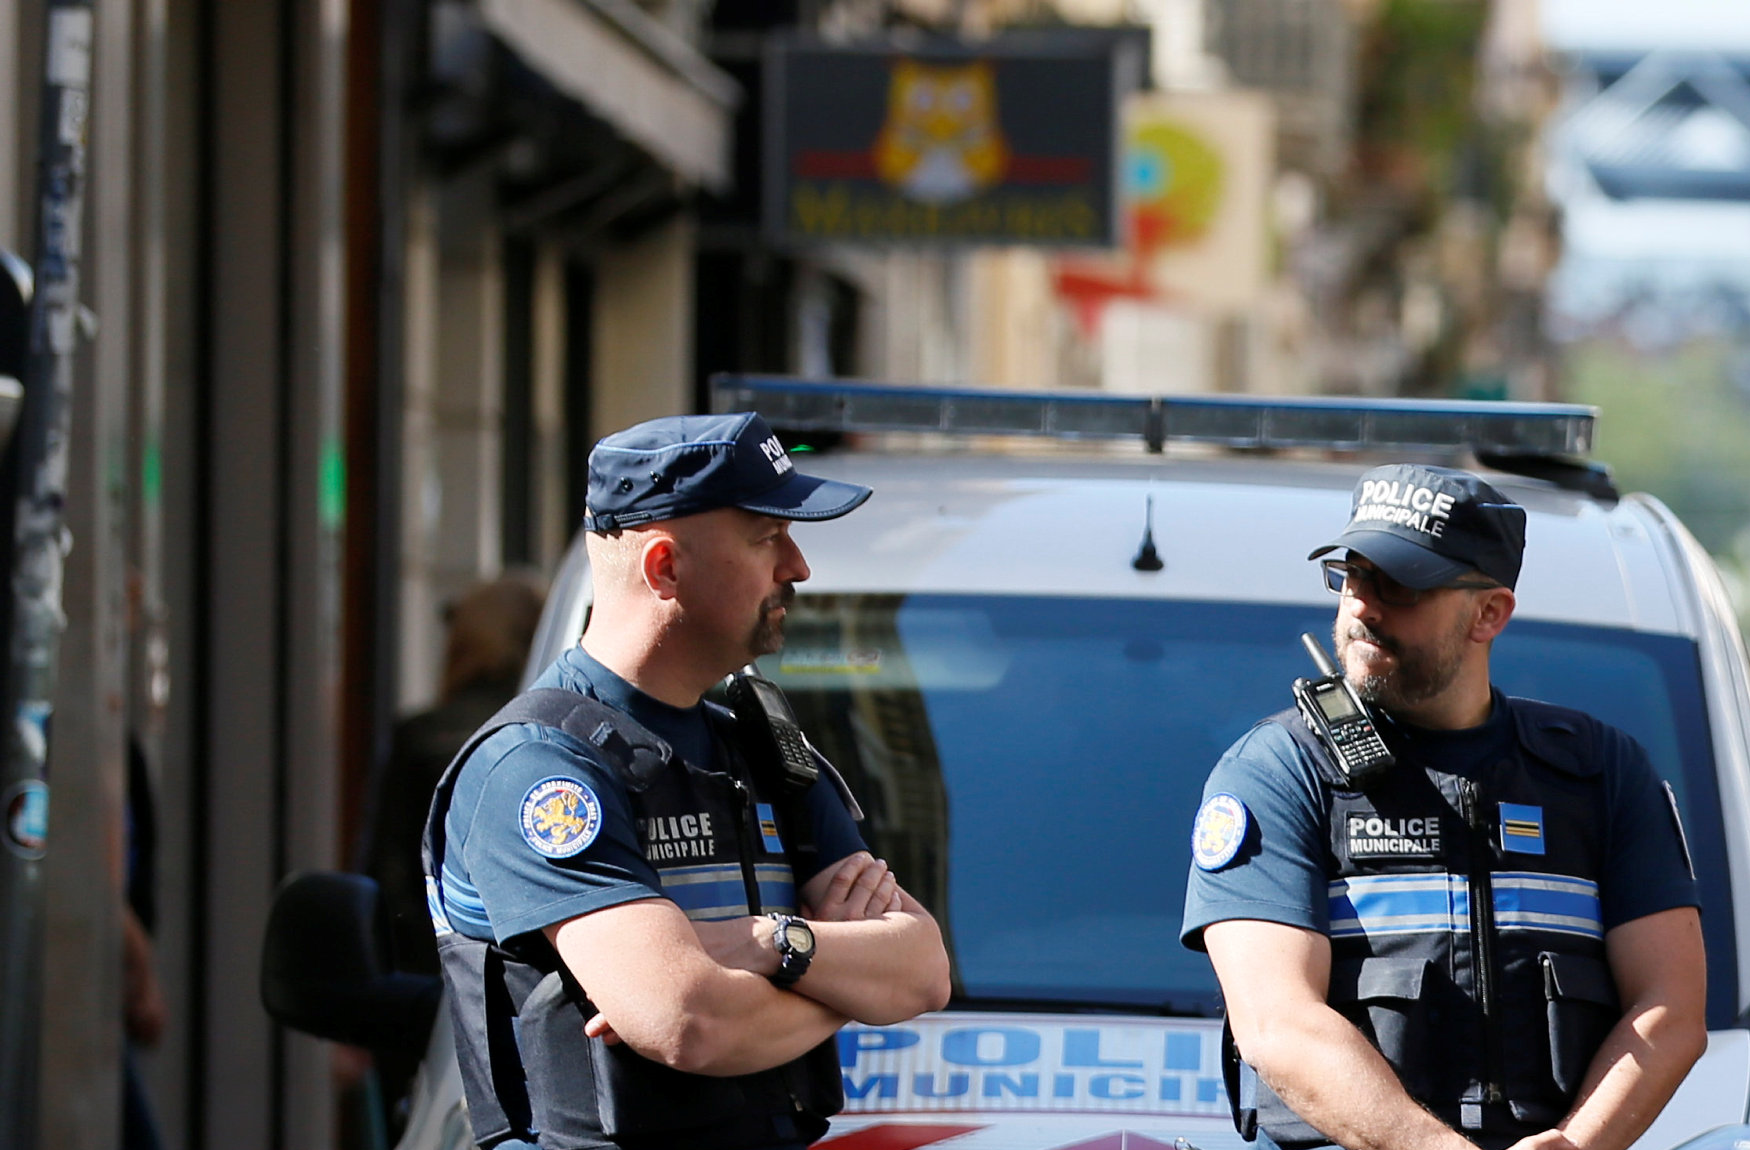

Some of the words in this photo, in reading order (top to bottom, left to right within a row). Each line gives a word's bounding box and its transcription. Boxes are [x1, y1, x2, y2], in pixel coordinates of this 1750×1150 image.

[1359, 479, 1456, 519] POLICE
[1354, 504, 1445, 538] MUNICIPALE
[638, 813, 712, 841] OLICE
[1350, 817, 1440, 837] POLICE
[1349, 838, 1440, 854] MUNICIPALE
